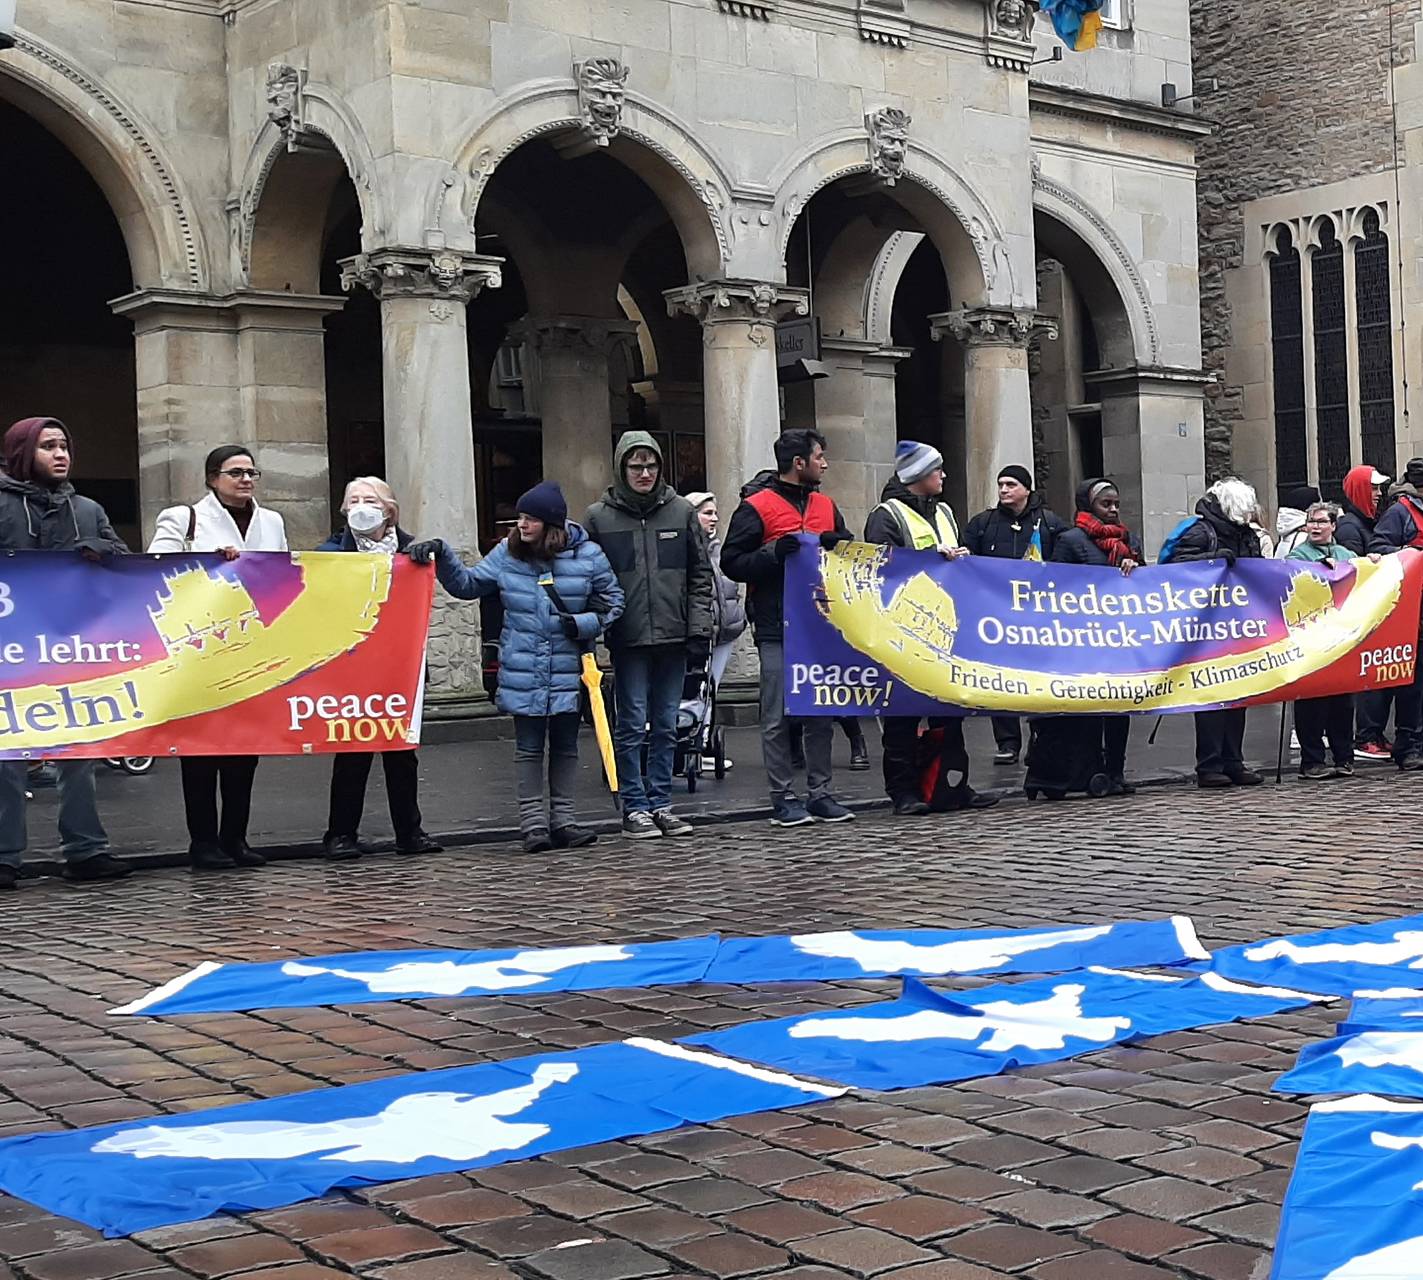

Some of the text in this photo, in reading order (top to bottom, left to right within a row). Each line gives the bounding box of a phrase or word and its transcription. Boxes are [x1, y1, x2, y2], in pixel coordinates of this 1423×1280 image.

[1009, 580, 1249, 615] Friedenskette
[978, 616, 1267, 648] Osnabrück-Münster
[36, 634, 142, 664] lehrt:
[1360, 644, 1412, 676] peace
[791, 663, 879, 694] peace
[950, 664, 1029, 697] Frieden
[1051, 679, 1174, 704] Gerechtigkeit
[1191, 646, 1304, 690] Klimaschutz
[1376, 661, 1415, 682] now
[814, 681, 893, 707] now!
[286, 694, 407, 730] peace
[325, 717, 411, 742] now
